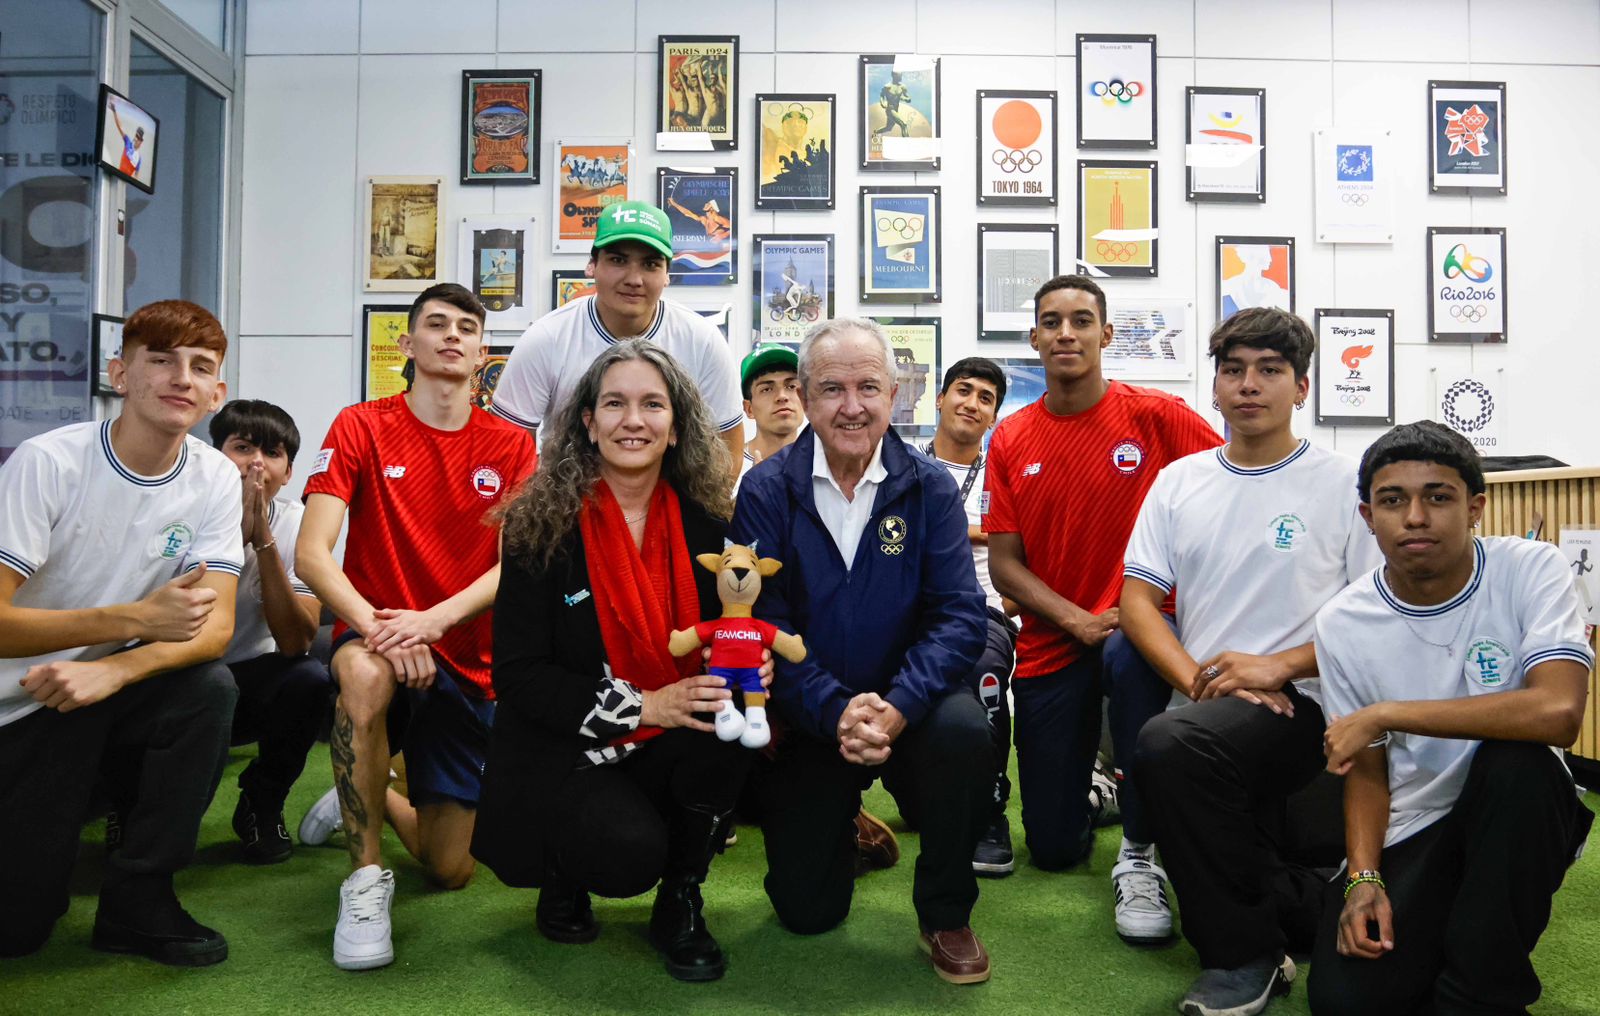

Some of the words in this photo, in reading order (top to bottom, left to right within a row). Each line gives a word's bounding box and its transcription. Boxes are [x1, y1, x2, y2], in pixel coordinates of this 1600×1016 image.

[25, 153, 56, 167] LE
[61, 153, 96, 167] DI
[992, 180, 1019, 193] TOKYO
[1023, 180, 1043, 193] 1964
[0, 312, 25, 332] Y
[1331, 327, 1356, 337] Beijing
[1335, 385, 1355, 393] Beijing
[1473, 437, 1497, 447] 2020
